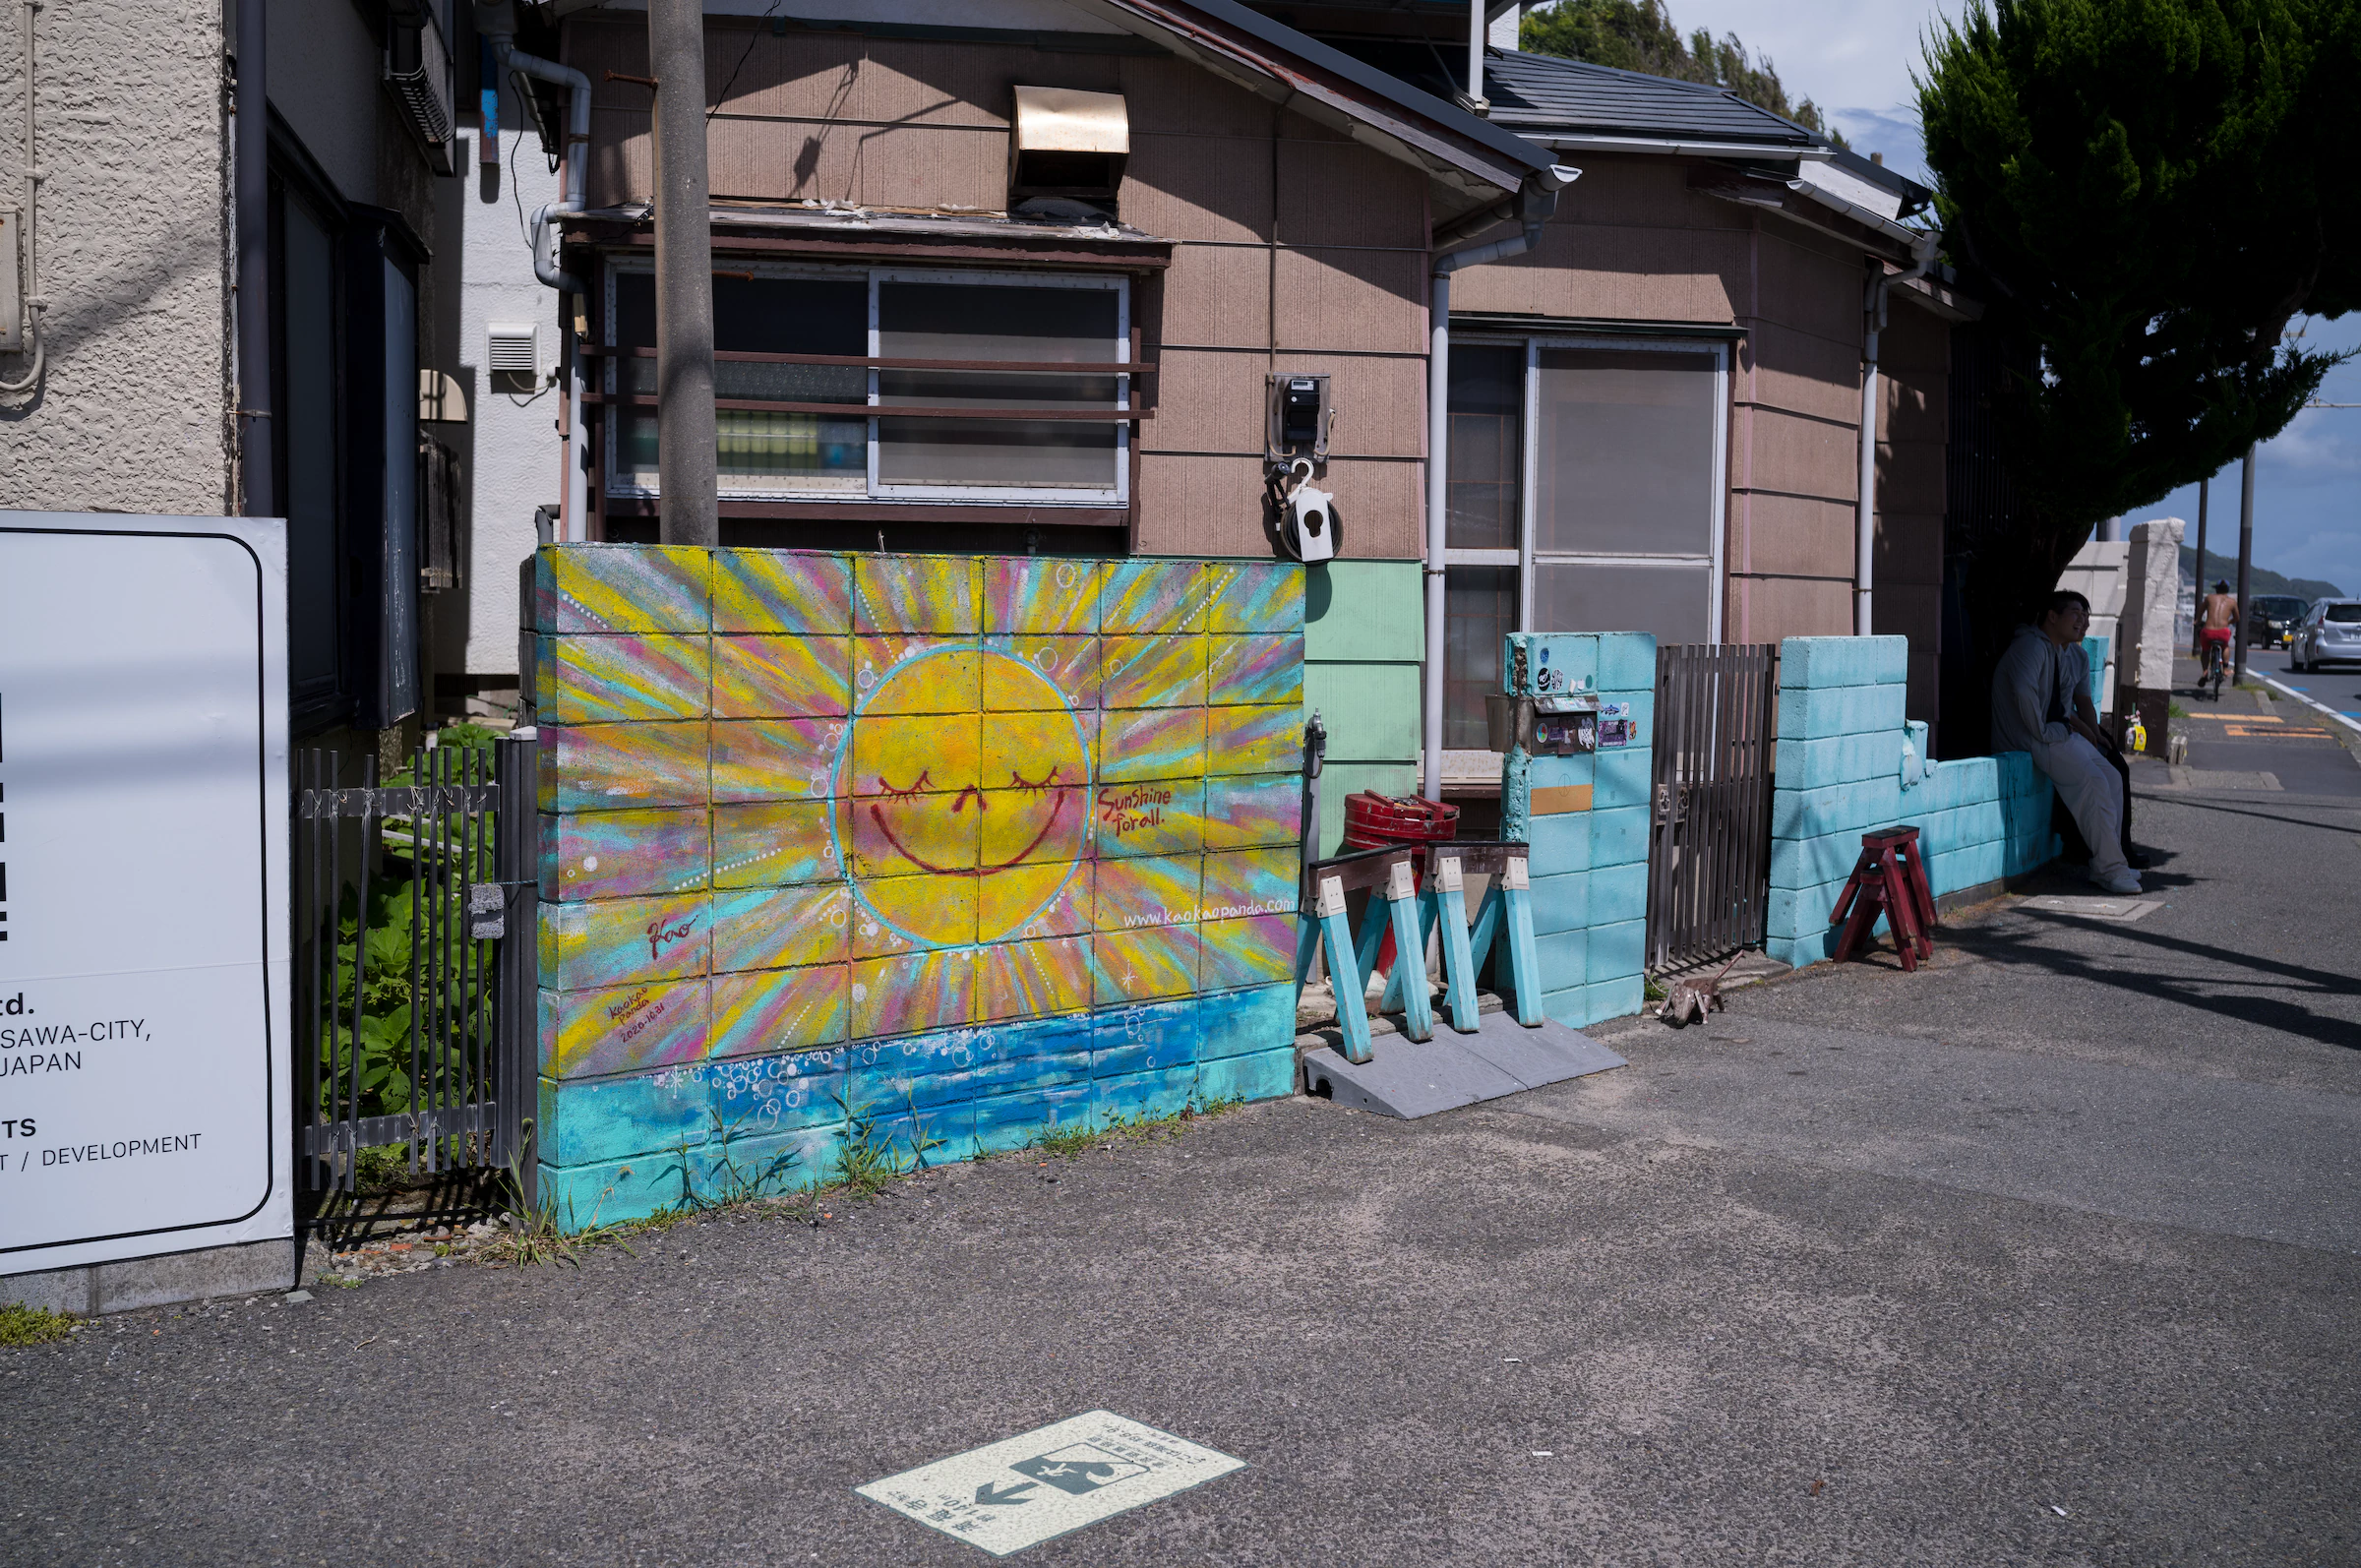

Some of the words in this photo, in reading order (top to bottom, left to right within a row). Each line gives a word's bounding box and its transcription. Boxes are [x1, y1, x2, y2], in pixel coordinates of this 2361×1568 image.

[1123, 899, 1296, 927] www.kaokaopanda.com
[0, 1018, 151, 1050] SAWA-CITY,
[0, 1051, 82, 1077] JAPAN
[1, 1117, 36, 1139] TS
[42, 1132, 202, 1167] DEVELOPMENT
